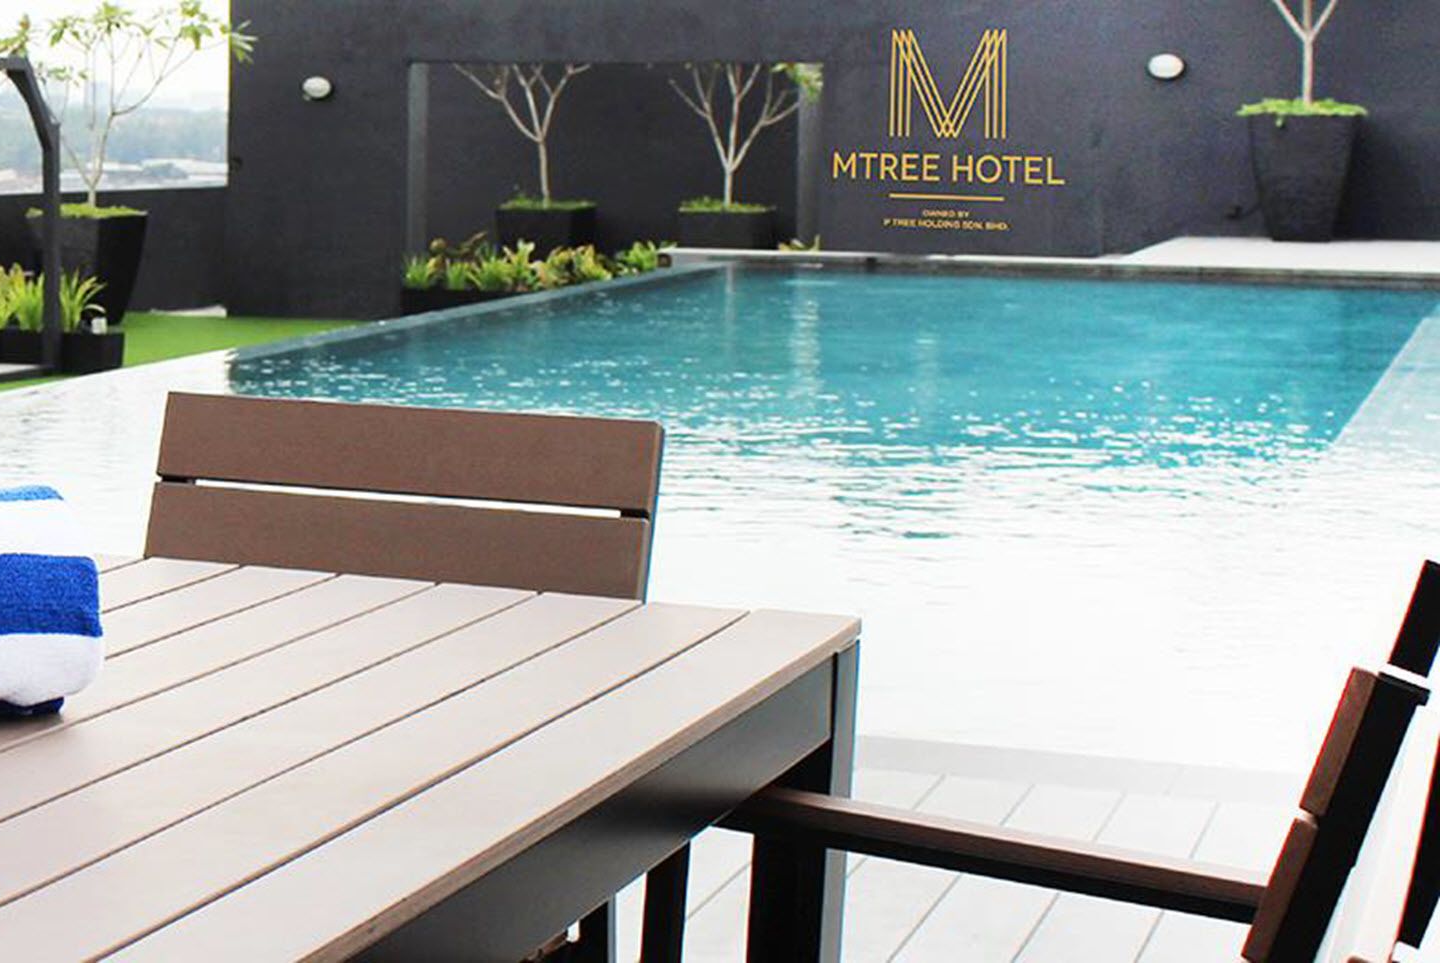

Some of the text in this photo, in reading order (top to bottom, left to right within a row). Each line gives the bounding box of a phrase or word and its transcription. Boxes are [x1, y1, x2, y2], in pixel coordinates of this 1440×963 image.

[890, 29, 1006, 139] M
[833, 151, 1065, 185] MTREE HOTEL
[893, 218, 917, 228] TREE
[918, 219, 960, 230] HOLDING
[958, 210, 970, 218] BY
